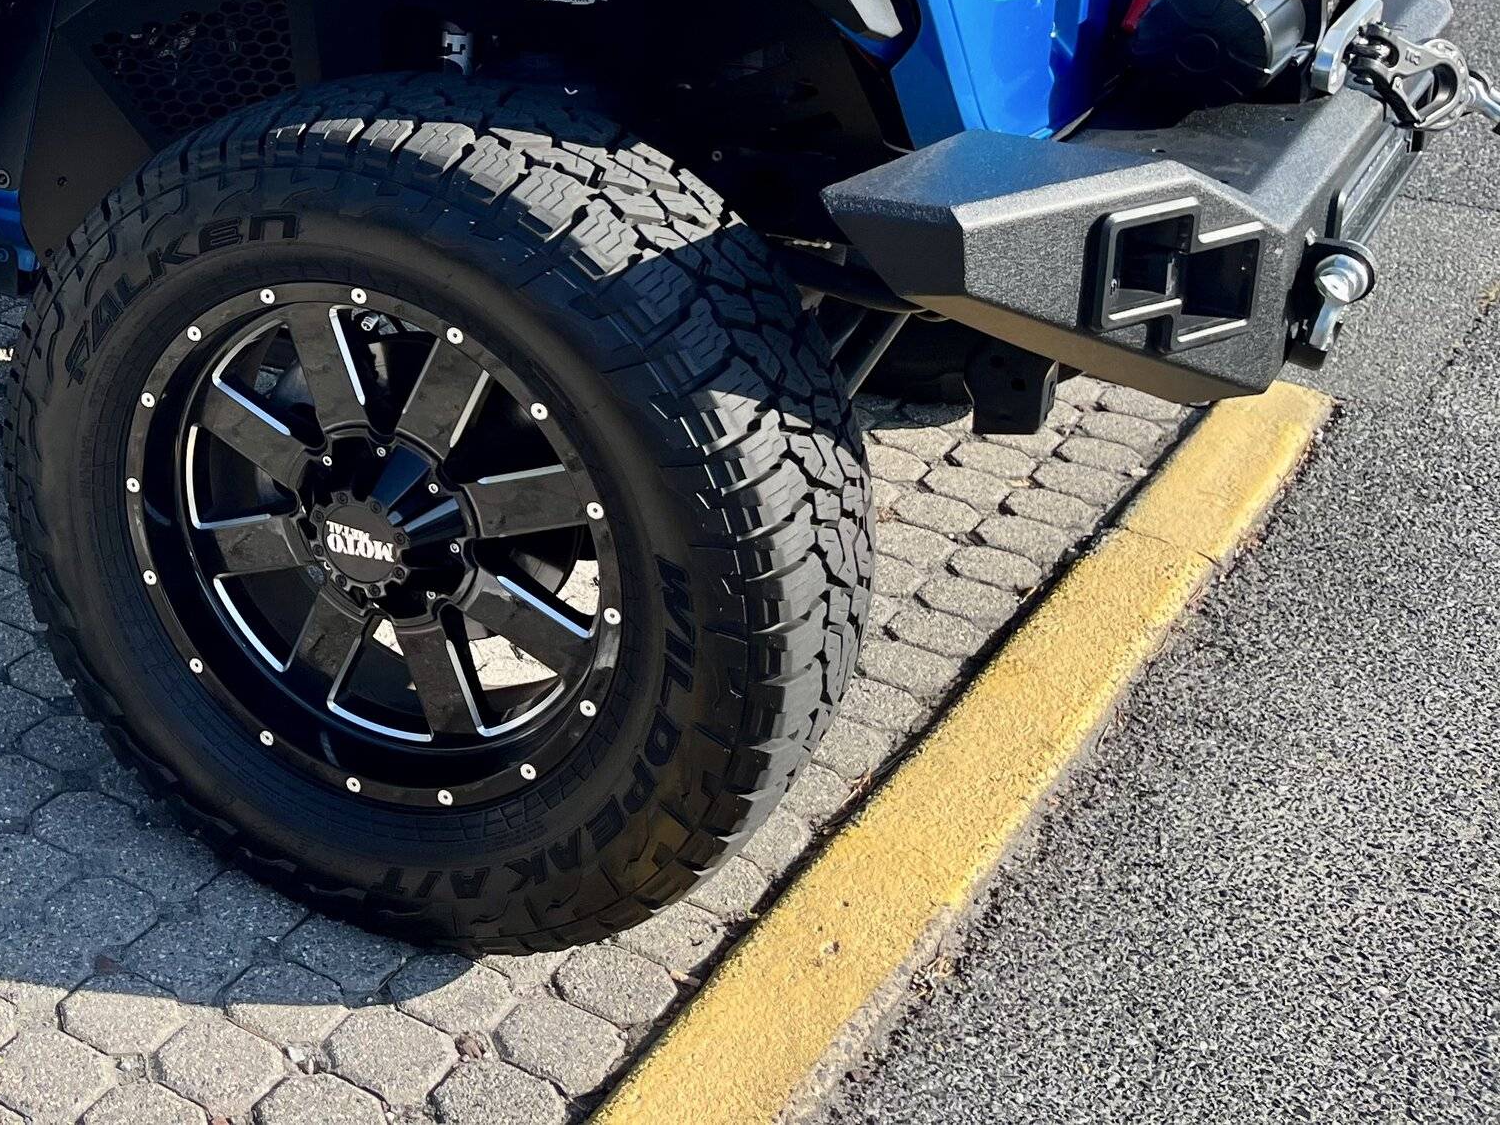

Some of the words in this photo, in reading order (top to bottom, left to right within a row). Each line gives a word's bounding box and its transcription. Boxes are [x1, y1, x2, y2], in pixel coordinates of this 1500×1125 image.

[64, 210, 300, 388] FALKEN
[327, 533, 395, 562] MOTO
[503, 554, 696, 895] WILDPEAK
